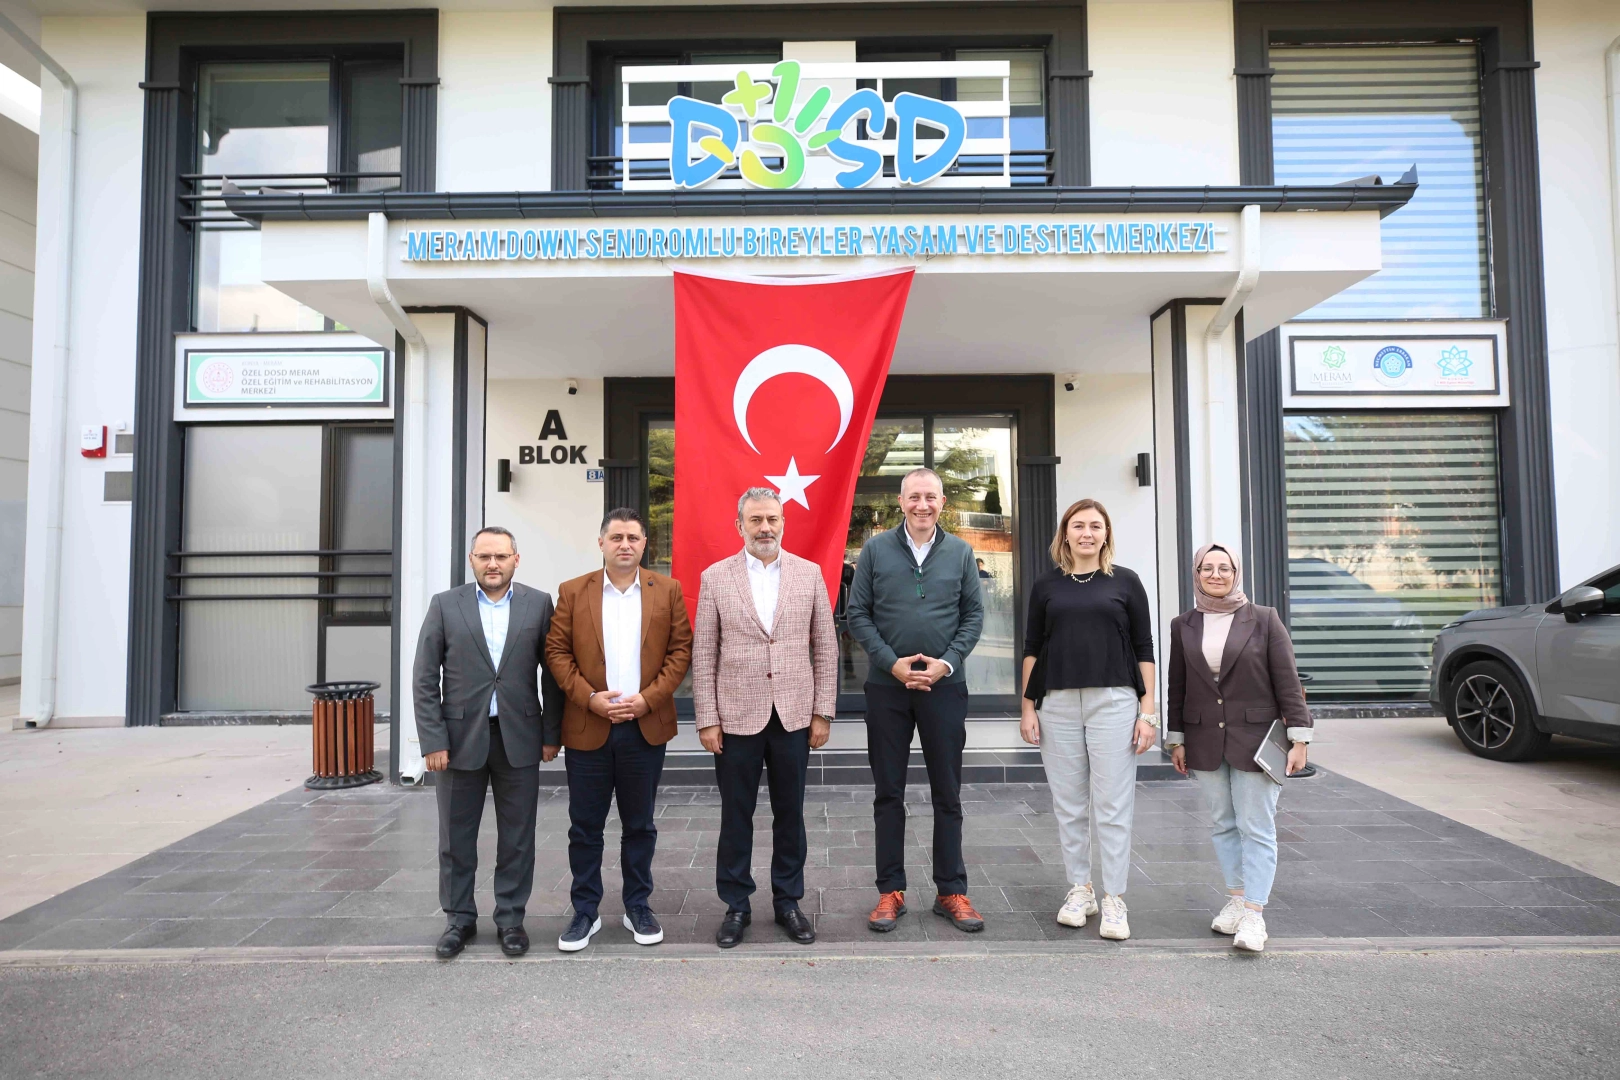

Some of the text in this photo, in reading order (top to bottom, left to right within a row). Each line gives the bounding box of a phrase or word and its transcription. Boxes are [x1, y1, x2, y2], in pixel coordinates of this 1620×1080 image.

[406, 229, 500, 261] MERAM
[506, 228, 579, 260] DOWN
[584, 227, 737, 258] SENDROMLU
[870, 224, 958, 257] YAŞAM
[963, 223, 996, 254] VE
[1002, 222, 1098, 254] DESTEK
[241, 368, 320, 377] ÖZEL DOSD MERAM
[1312, 372, 1353, 381] MERAM
[241, 377, 262, 386] ÖZEL
[263, 376, 292, 386] EĞİTİM
[304, 376, 373, 386] REHABİLİTASYON
[241, 386, 276, 395] MERKEZİ
[538, 409, 568, 440] A
[519, 445, 588, 465] BLOK
